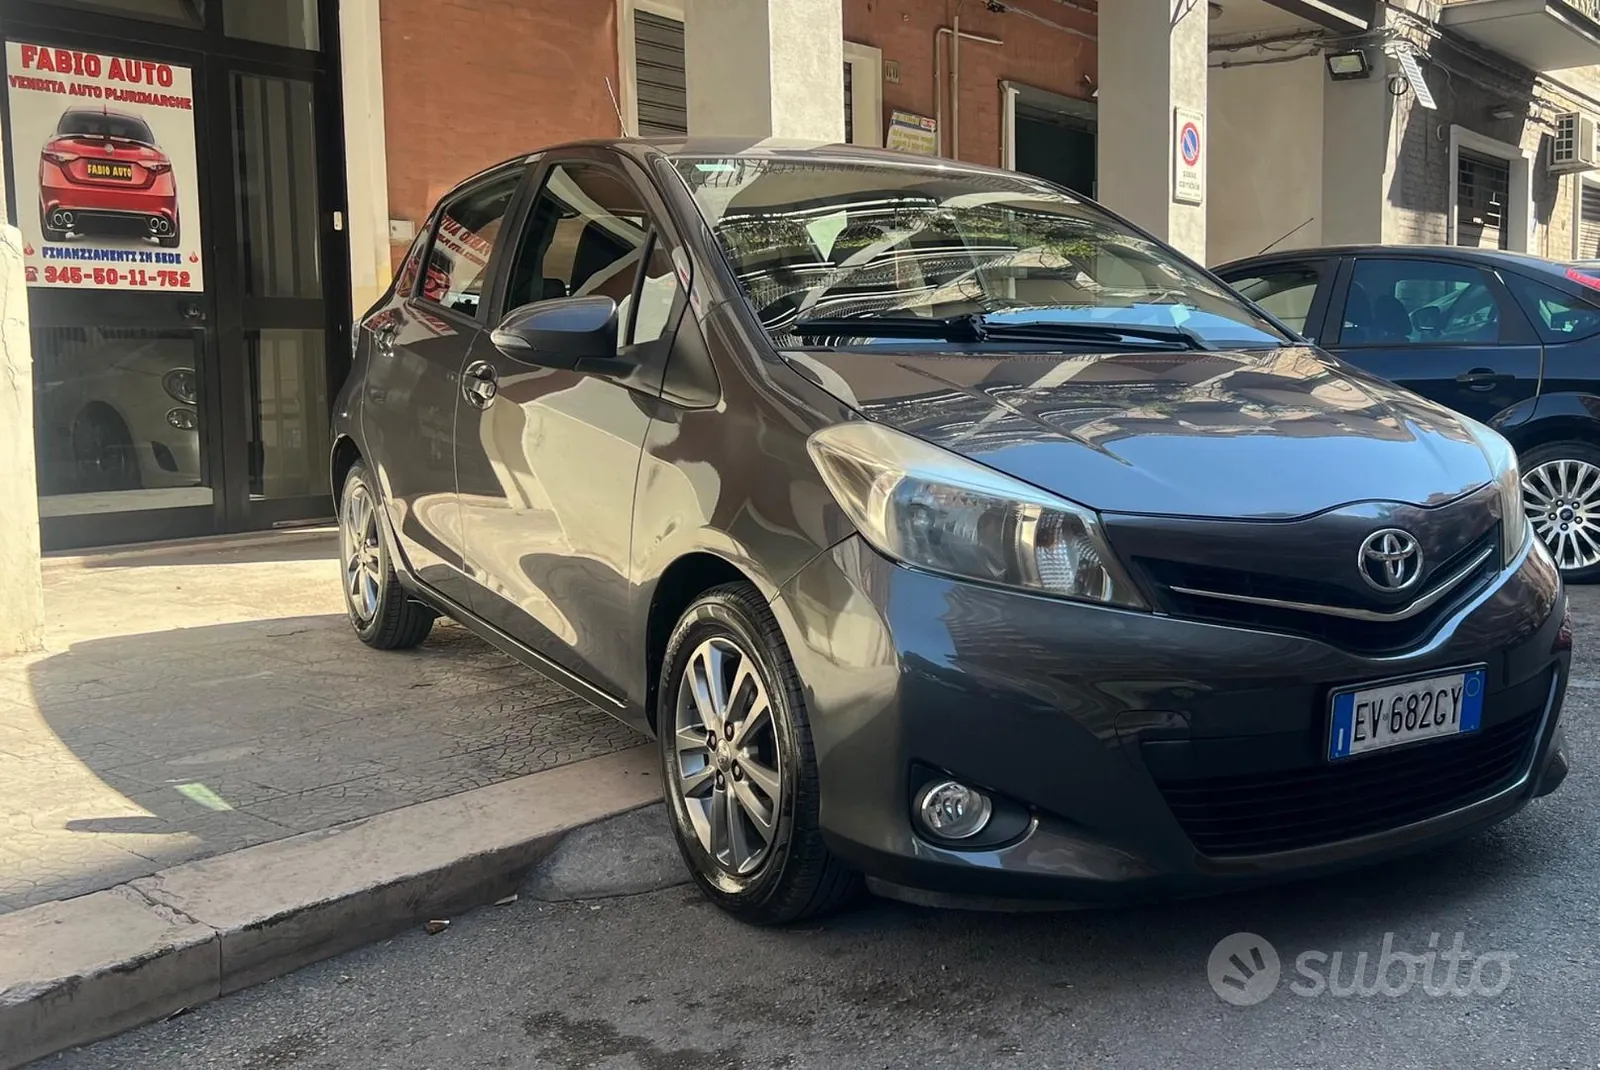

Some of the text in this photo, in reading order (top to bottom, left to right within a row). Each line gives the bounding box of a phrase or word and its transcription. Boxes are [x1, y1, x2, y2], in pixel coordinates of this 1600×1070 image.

[21, 44, 173, 88] FABIO AUTO
[8, 74, 192, 110] VENDITA AUTO PLURIMARCHE
[87, 164, 132, 178] FABIO AUTO
[42, 246, 182, 264] FINANZIAMENTI IN SEDE
[44, 265, 190, 288] 345-50-11-752
